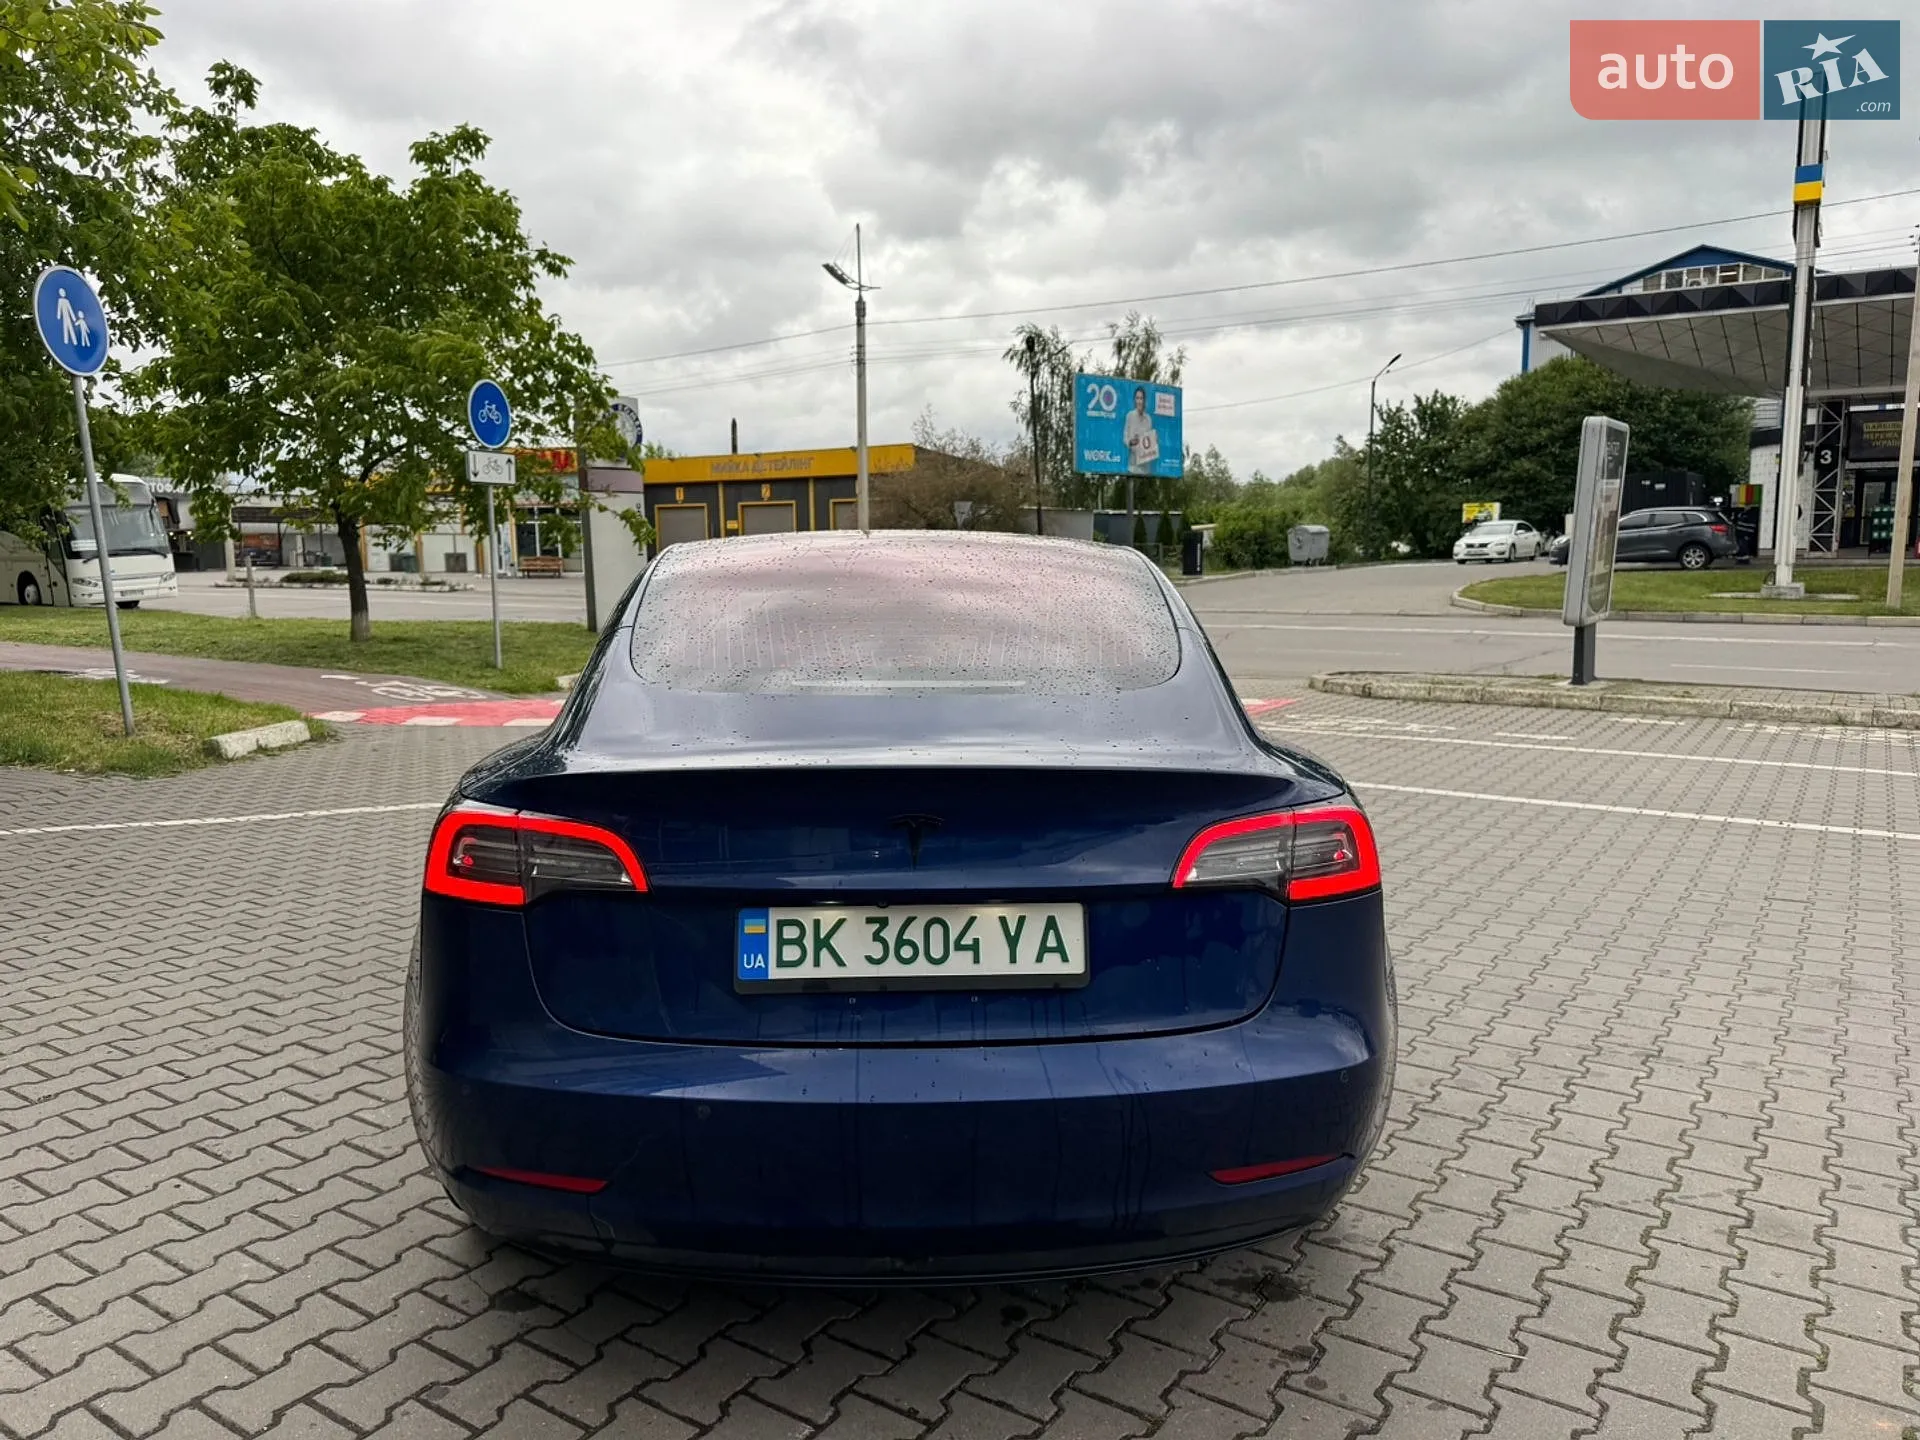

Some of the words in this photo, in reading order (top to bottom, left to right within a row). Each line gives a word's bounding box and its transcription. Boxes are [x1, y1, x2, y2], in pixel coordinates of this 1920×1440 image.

[1086, 383, 1117, 412] 20
[1820, 449, 1832, 464] 3
[775, 917, 847, 969] BK
[864, 915, 981, 966] 3604
[998, 914, 1070, 964] YA
[743, 953, 766, 970] UA
